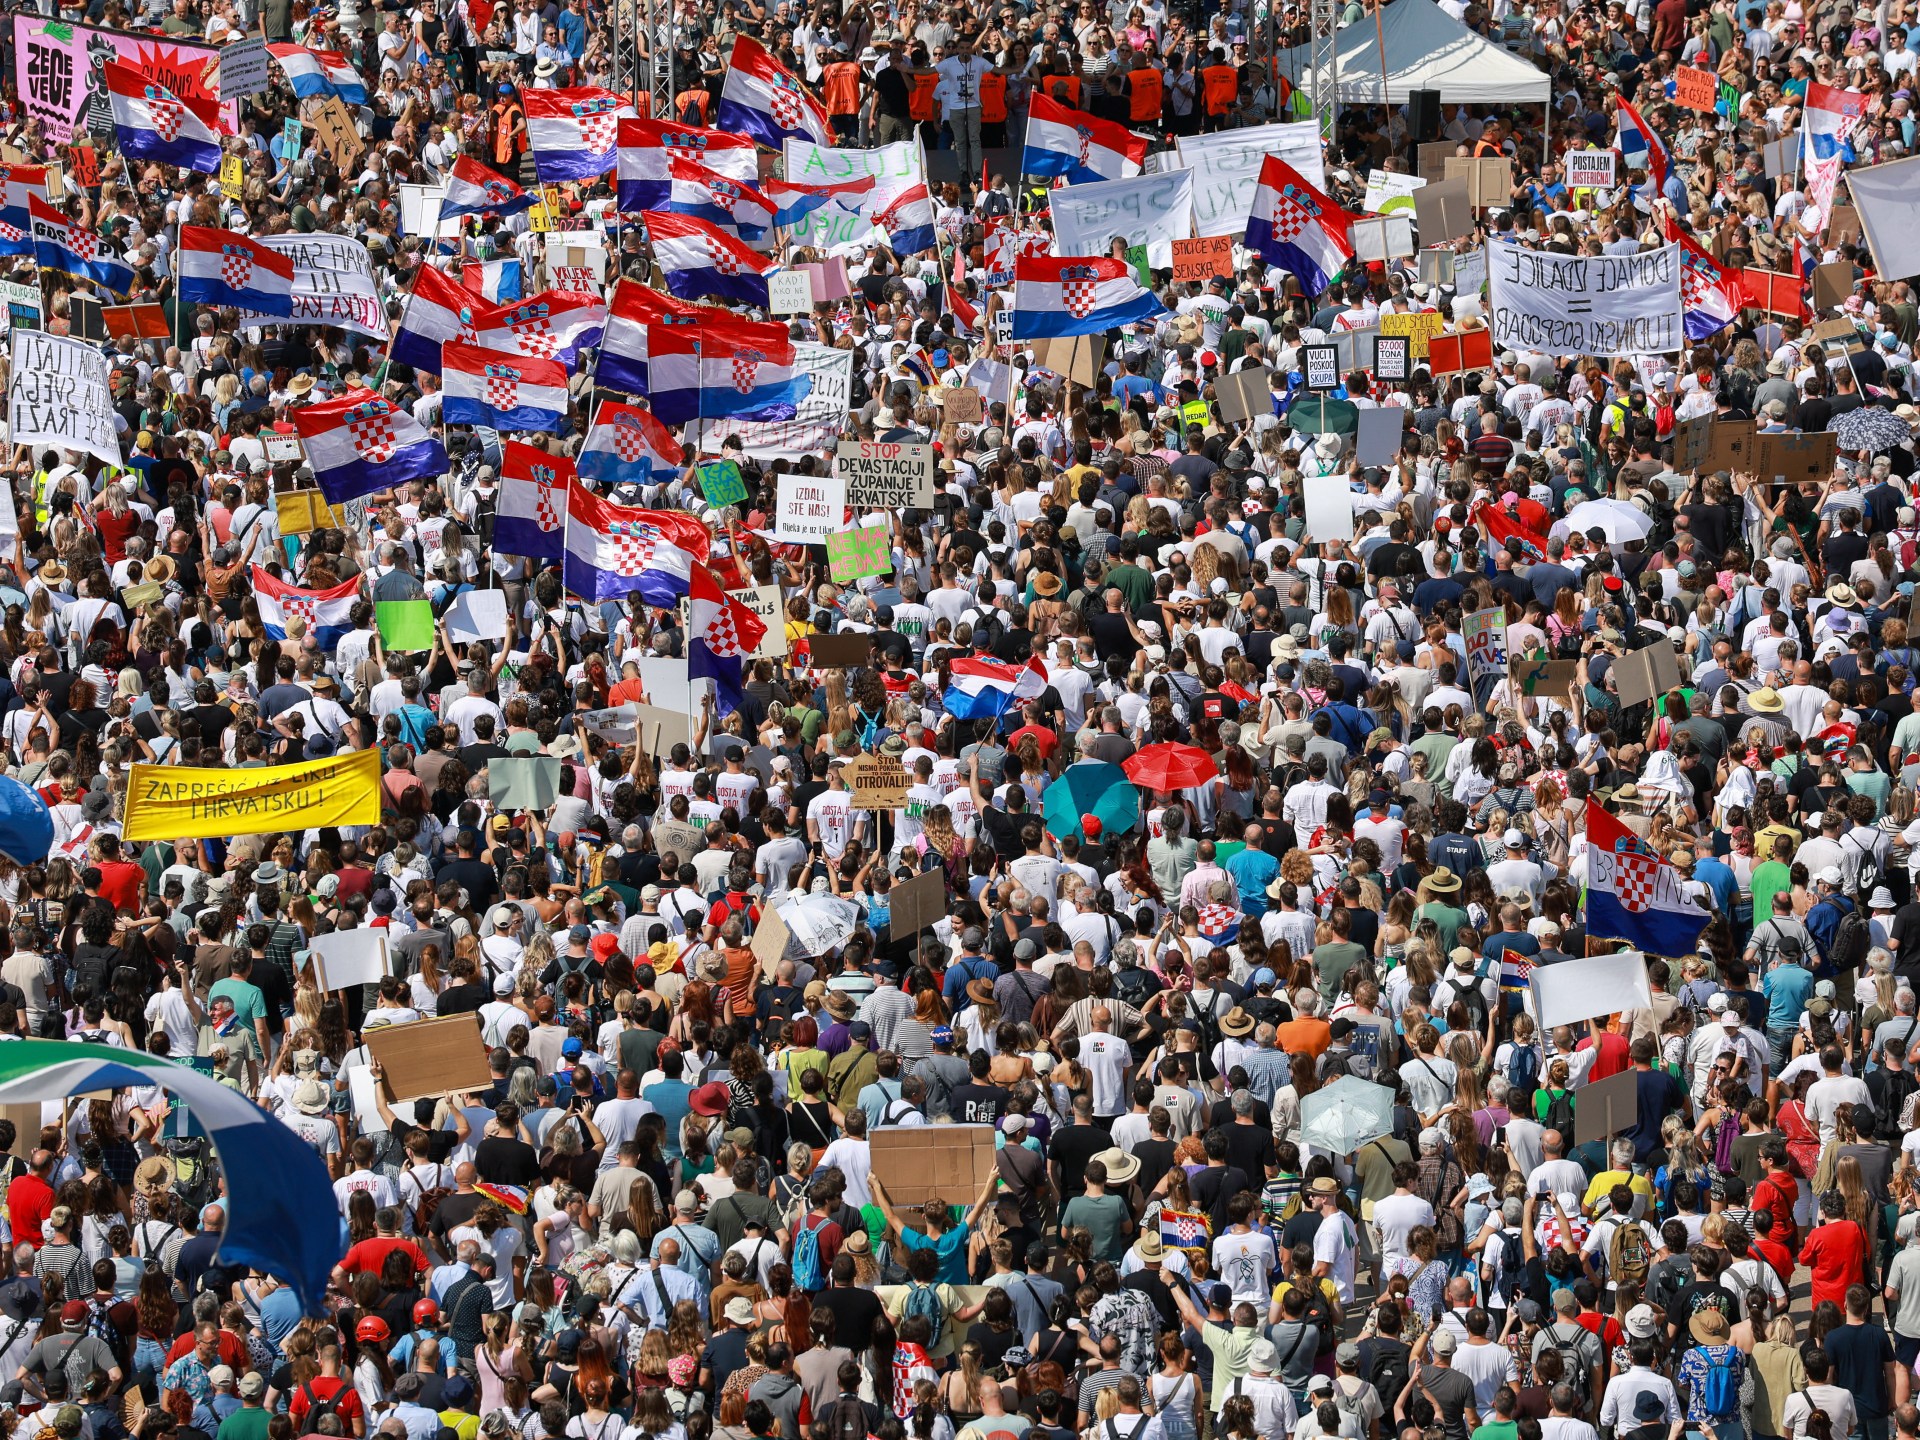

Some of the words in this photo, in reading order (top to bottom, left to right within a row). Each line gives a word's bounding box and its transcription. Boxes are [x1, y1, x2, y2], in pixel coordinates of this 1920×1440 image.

[1573, 156, 1610, 171] POSTAJEM
[1210, 241, 1229, 252] VAS
[552, 267, 597, 281] VRIJEME
[777, 275, 803, 285] KAD?
[556, 281, 568, 292] JE
[571, 280, 591, 292] ZA
[773, 287, 793, 295] AKO
[780, 299, 806, 308] SAD?
[1383, 315, 1407, 330] KADA
[1379, 341, 1404, 350] 37.000
[1309, 350, 1324, 361] VUCI
[1310, 373, 1335, 385] SKUPA!
[1186, 412, 1206, 420] REDAR
[861, 443, 901, 459] STOP
[839, 458, 925, 476] DEVASTACIJI
[850, 473, 913, 490] ŽUPANIJE
[918, 478, 923, 490] I
[795, 488, 825, 501] IZDALI
[846, 489, 916, 507] HRVATSKE
[788, 503, 804, 515] STE
[808, 503, 830, 518] NAS!
[782, 522, 800, 533] Rijeka
[802, 524, 808, 535] je
[809, 526, 816, 534] uz
[831, 548, 891, 579] PREDAJE
[877, 754, 895, 765] ŠTO
[858, 764, 877, 772] NISMO
[879, 764, 903, 772] POKRALI
[856, 776, 913, 789] OTROVALI!!!
[665, 785, 684, 795] DOSTA
[717, 787, 738, 797] DOSTA
[740, 789, 747, 799] JE
[203, 789, 310, 819] HRVATSKU
[318, 788, 325, 808] !
[823, 805, 842, 816] DOSTA
